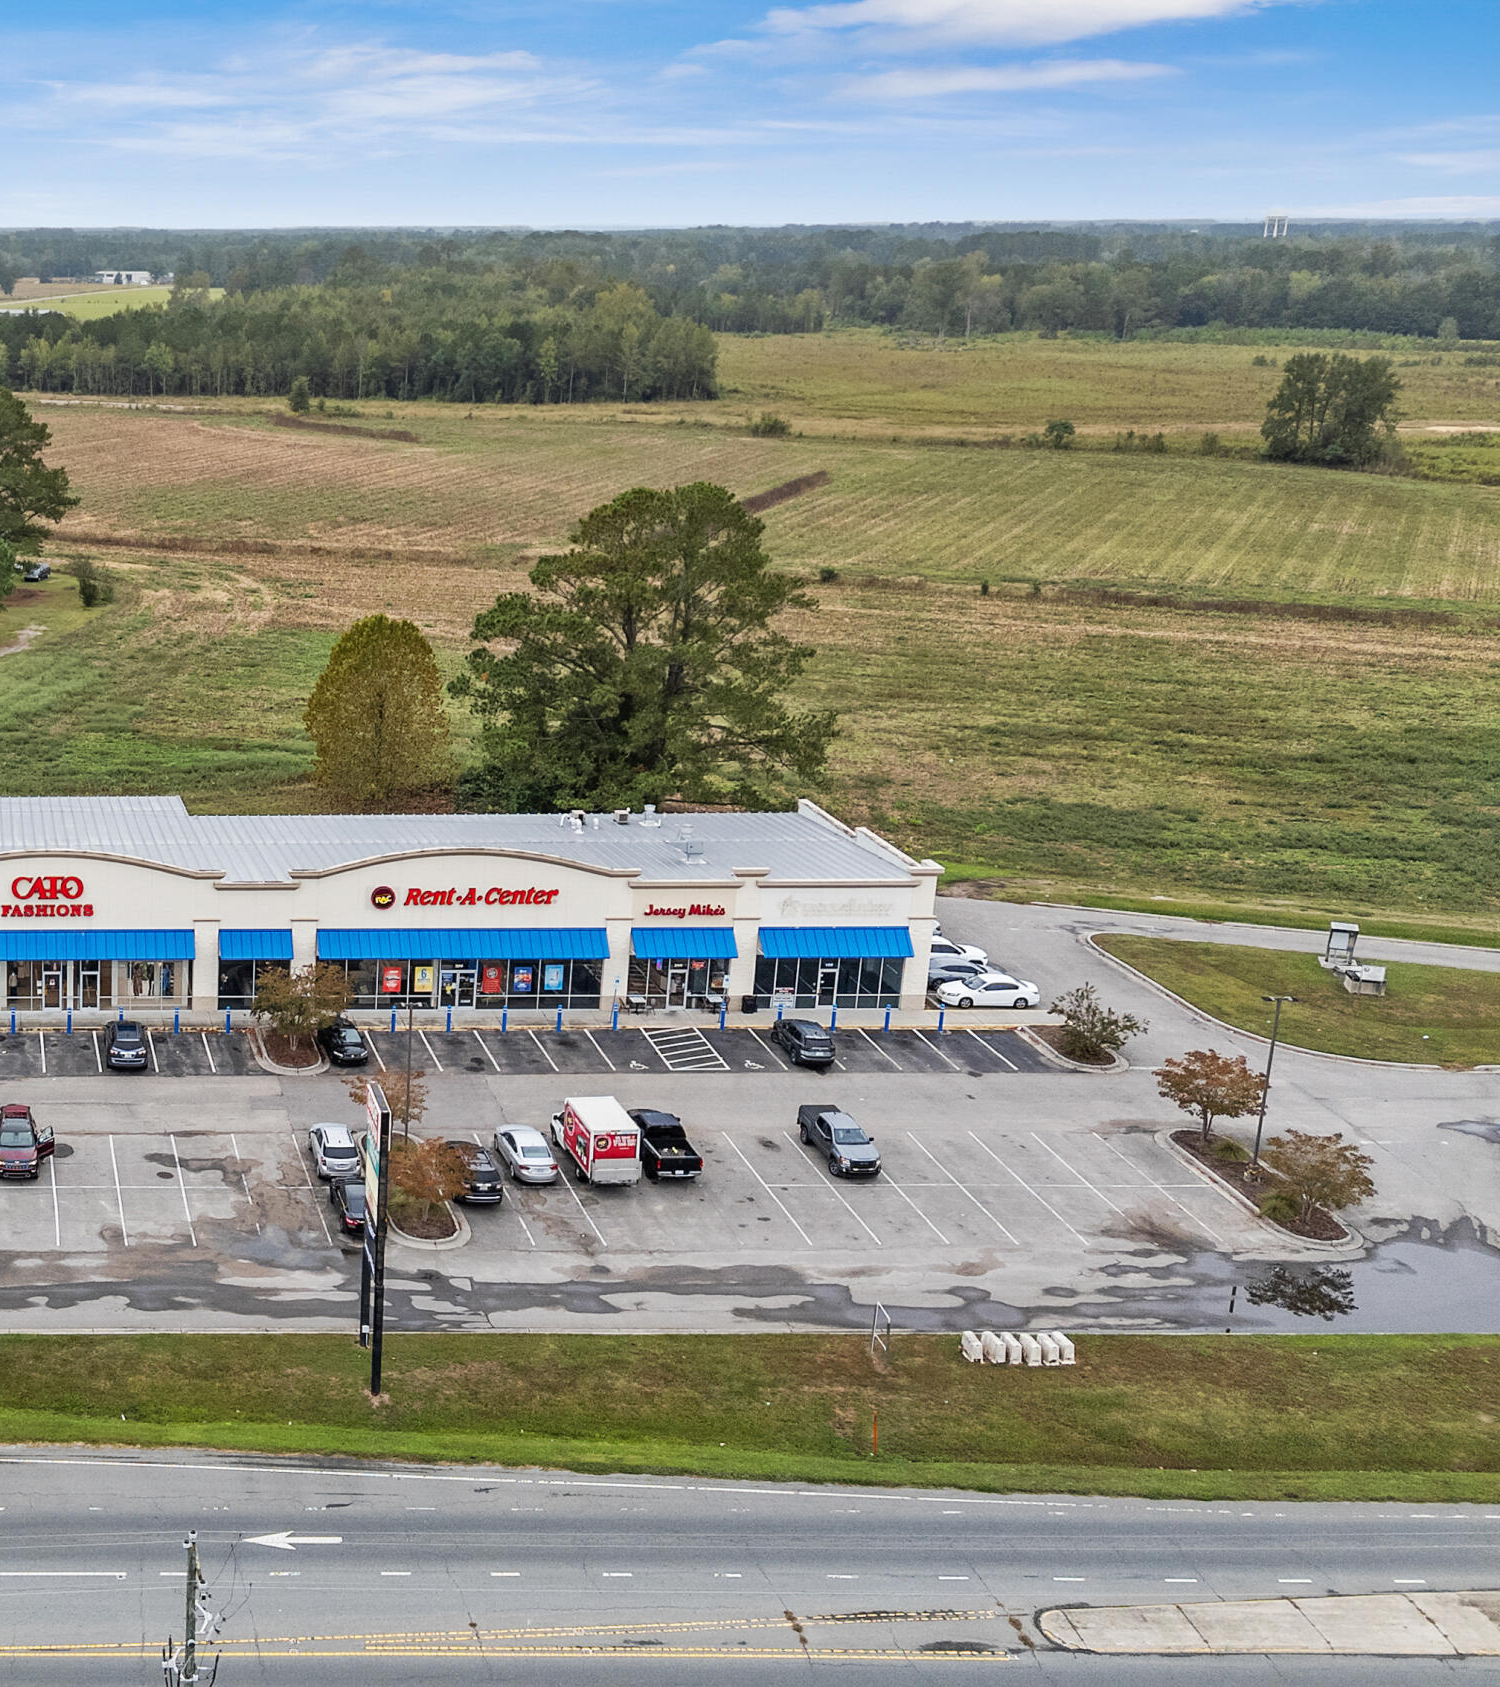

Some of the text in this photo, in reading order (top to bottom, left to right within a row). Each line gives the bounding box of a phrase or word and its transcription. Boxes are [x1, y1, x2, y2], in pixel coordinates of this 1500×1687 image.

[12, 877, 84, 899] CATO
[2, 905, 94, 917] FASHIONS
[644, 904, 726, 919] Jersey Mike's
